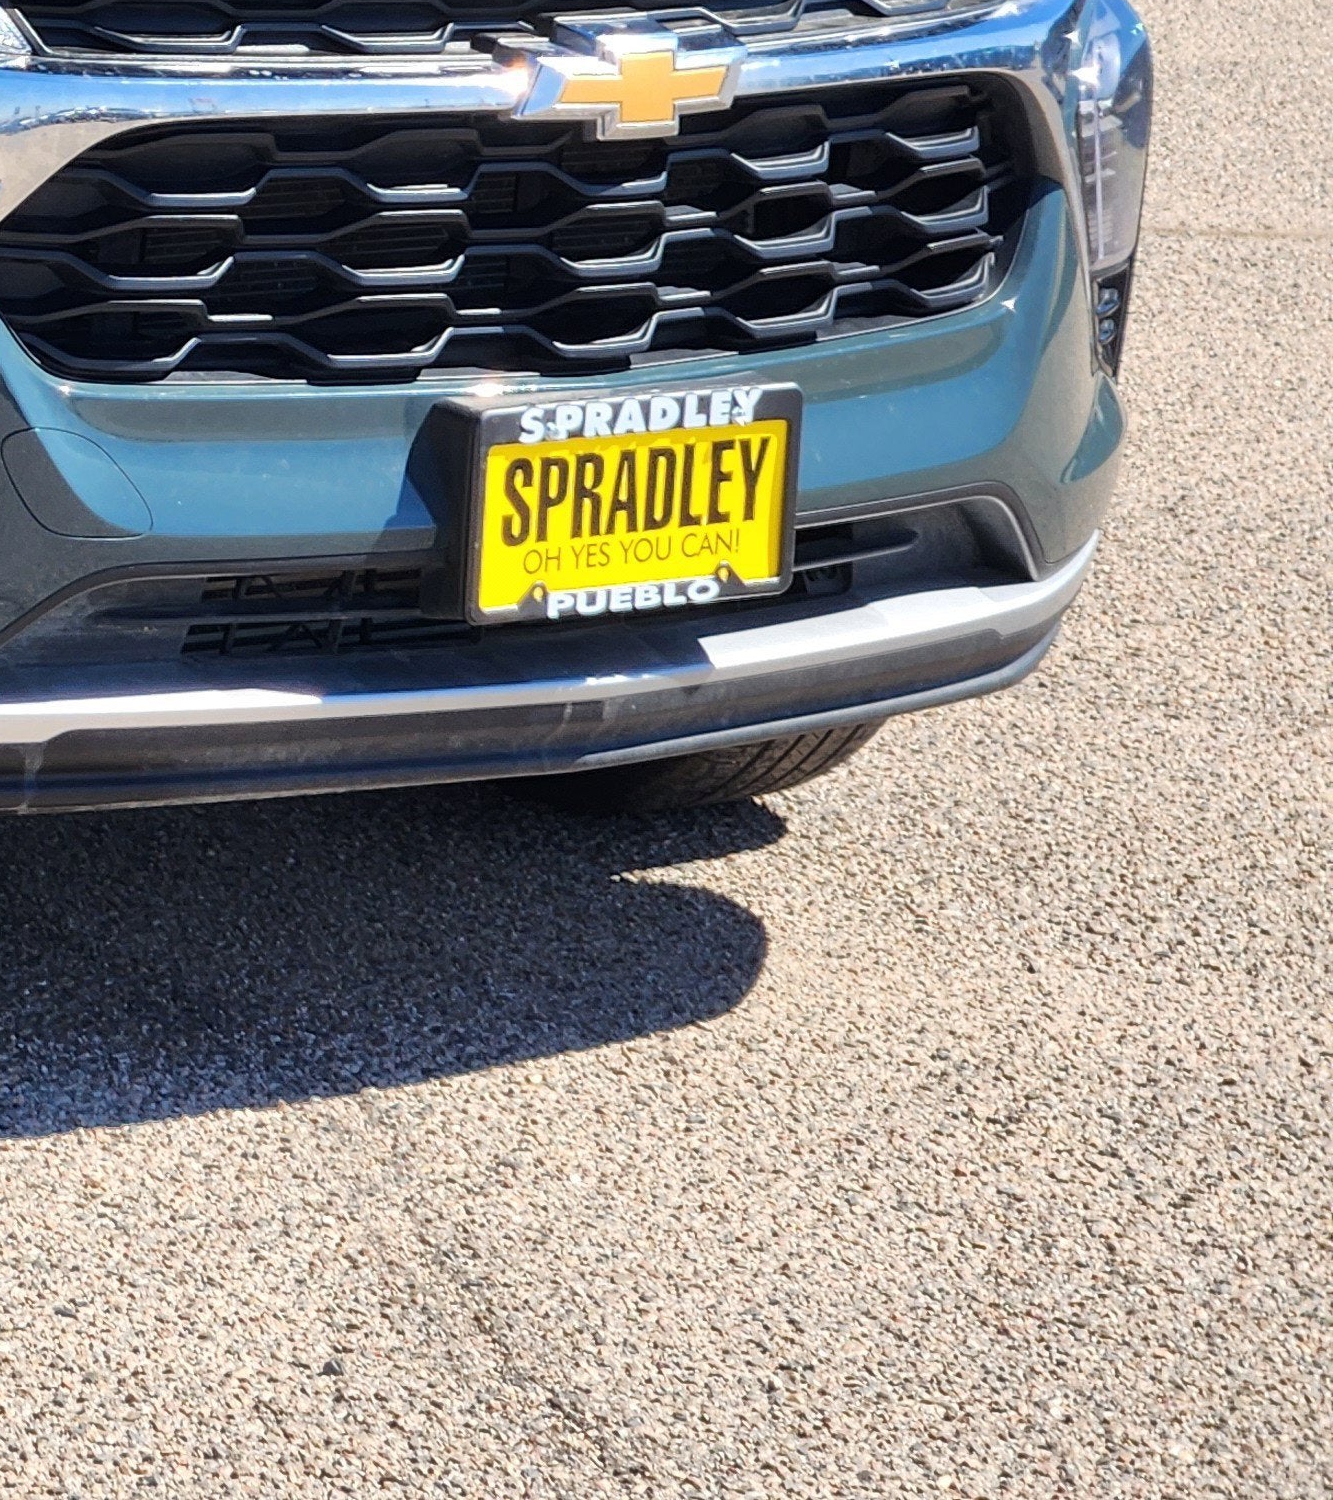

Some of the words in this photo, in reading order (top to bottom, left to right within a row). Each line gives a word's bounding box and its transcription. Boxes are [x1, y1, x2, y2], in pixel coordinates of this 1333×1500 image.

[519, 388, 763, 444] SPRADLEY
[501, 436, 771, 547] SPRADLEY
[523, 548, 561, 575] OH
[572, 542, 610, 569] YES
[621, 536, 671, 564] YOU
[681, 529, 740, 558] CAN!
[546, 577, 720, 620] PUEBLO
